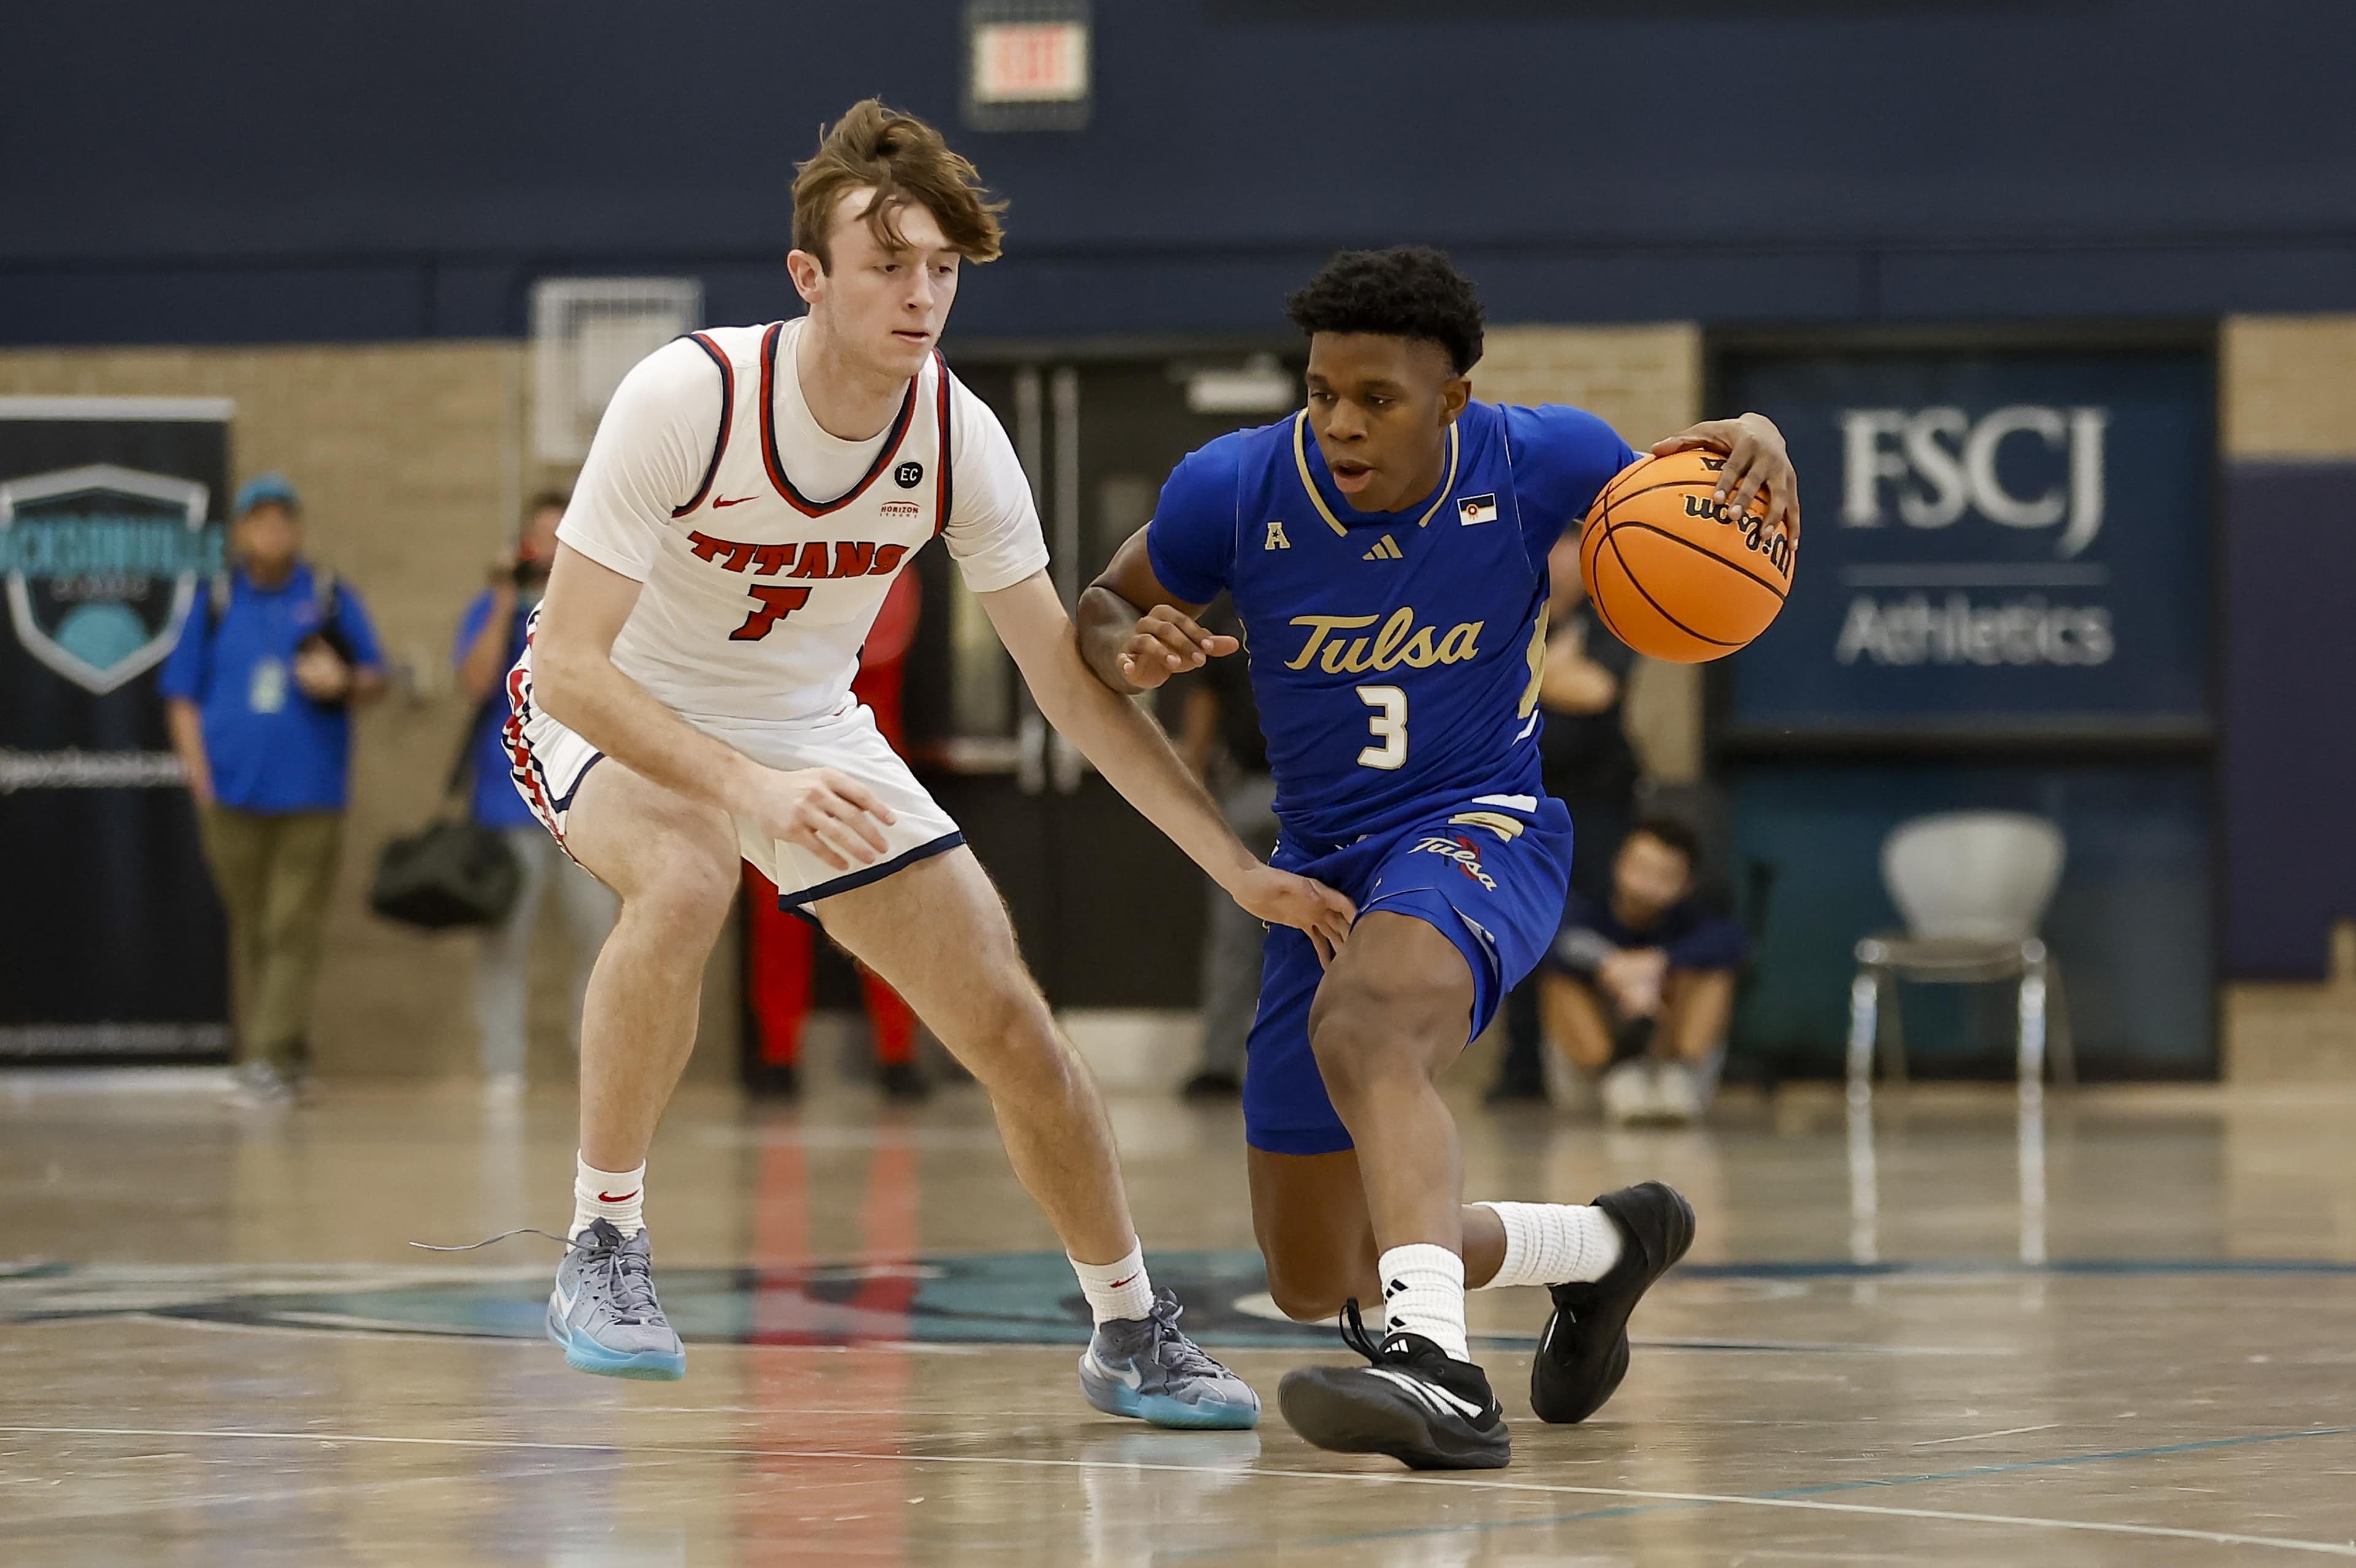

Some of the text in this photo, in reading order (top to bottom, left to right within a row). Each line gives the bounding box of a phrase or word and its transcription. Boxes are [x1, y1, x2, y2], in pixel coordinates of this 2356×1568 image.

[900, 467, 918, 481] EC
[1839, 405, 2109, 558] FSCJ
[880, 505, 918, 514] HORIZON
[687, 531, 910, 578] TITANS
[729, 584, 813, 641] 7
[1284, 606, 1484, 674] Tulsa
[1834, 591, 2115, 666] Athletics
[1355, 685, 1407, 769] 3
[1407, 837, 1497, 892] Tulsa
